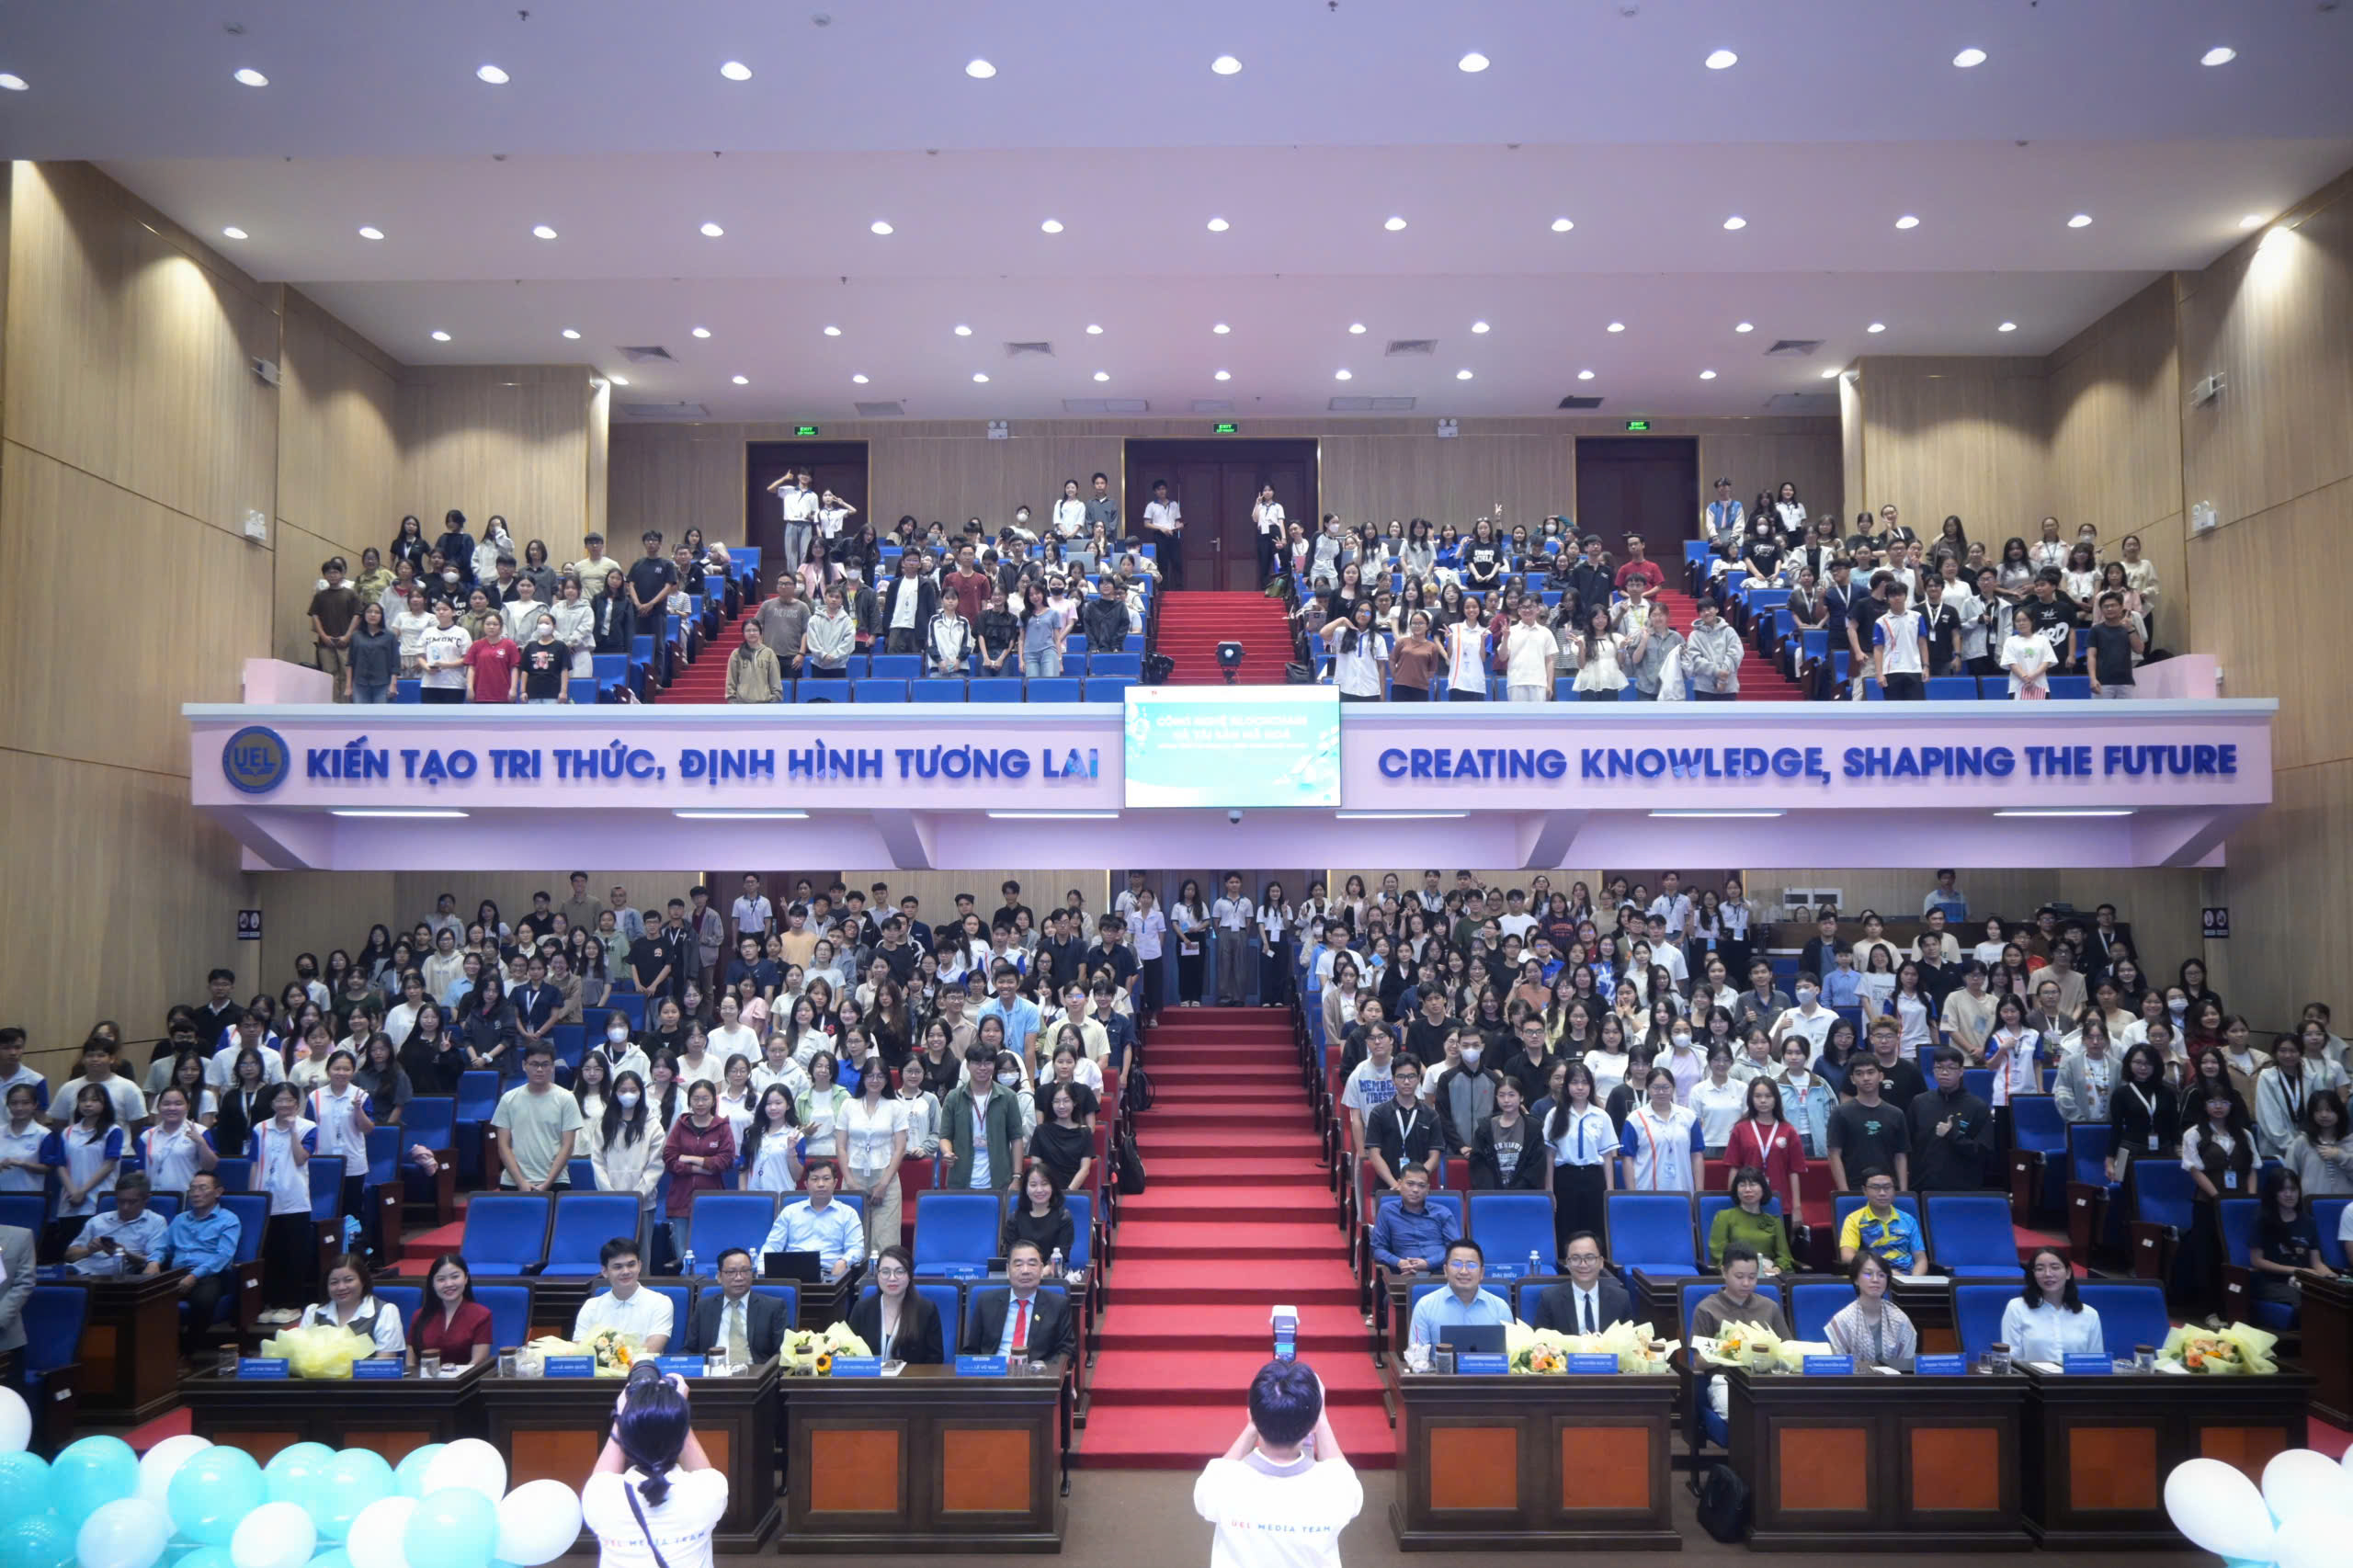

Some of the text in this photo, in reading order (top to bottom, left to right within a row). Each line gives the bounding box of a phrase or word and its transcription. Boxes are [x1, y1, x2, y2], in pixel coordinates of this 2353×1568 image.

[234, 746, 276, 767] UEL
[308, 734, 1099, 788] KIẾN TẠO TRI THỨC, ĐỊNH HÌNH TƯƠNG LAI
[1378, 744, 2238, 787] CREATING KNOWLEDGE, SHAPING THE FUTURE
[1359, 1080, 1394, 1092] MEMBE
[1257, 1523, 1295, 1533] MEDIA
